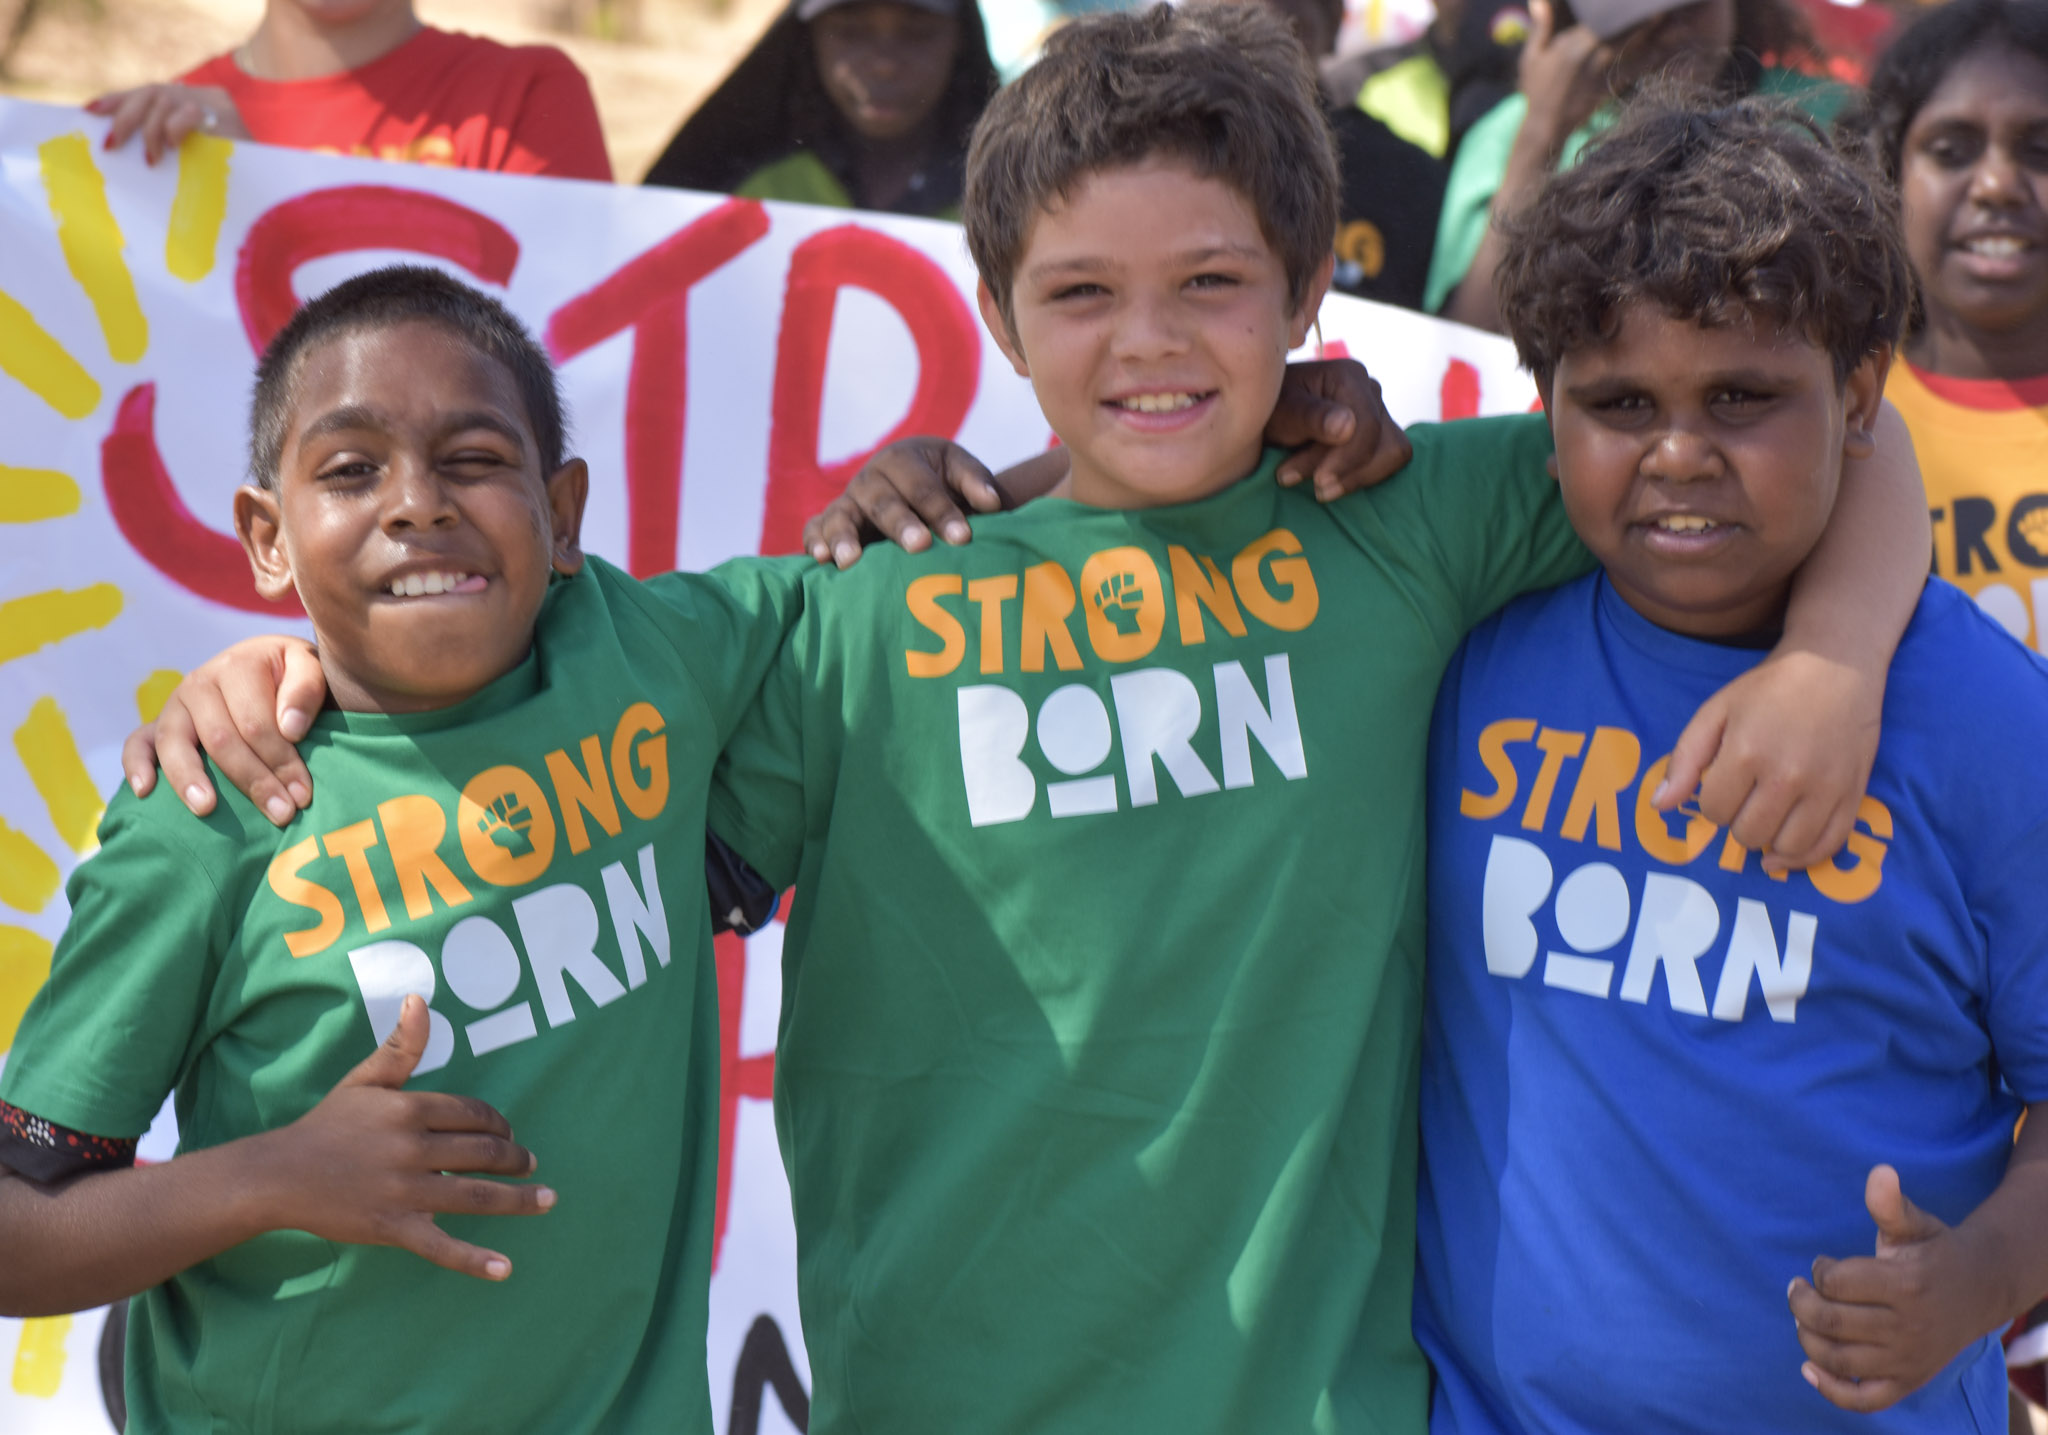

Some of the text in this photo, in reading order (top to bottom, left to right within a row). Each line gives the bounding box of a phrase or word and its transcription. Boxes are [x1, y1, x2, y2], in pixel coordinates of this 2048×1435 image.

[905, 527, 1320, 679] STRONG
[267, 701, 671, 959] STRONG
[956, 652, 1309, 828] BORN
[1459, 717, 1894, 905] STROG
[346, 842, 672, 1078] BORN
[1482, 833, 1819, 1025] BORN
